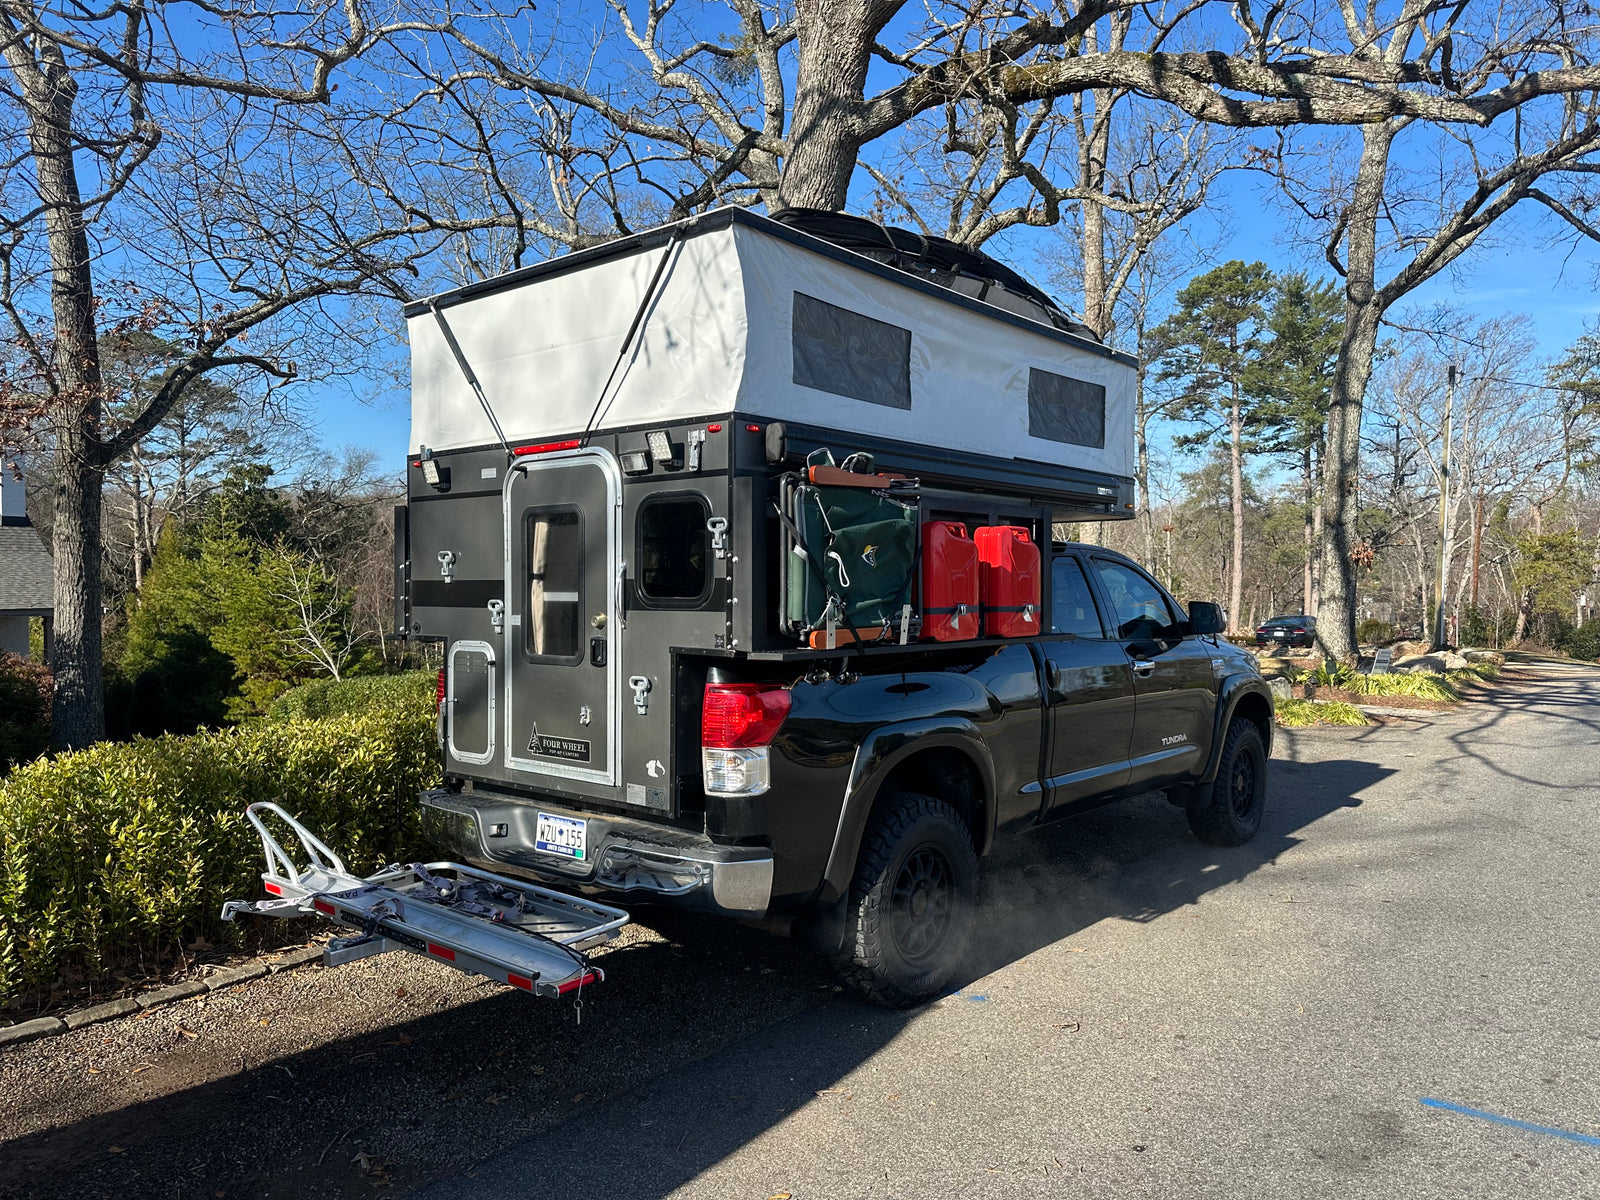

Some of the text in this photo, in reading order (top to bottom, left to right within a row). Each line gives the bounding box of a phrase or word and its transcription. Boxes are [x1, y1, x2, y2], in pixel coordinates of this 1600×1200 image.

[543, 739, 586, 753] FOUR WHEEL
[1161, 733, 1187, 746] TUNDRA
[540, 823, 583, 848] WZU 155
